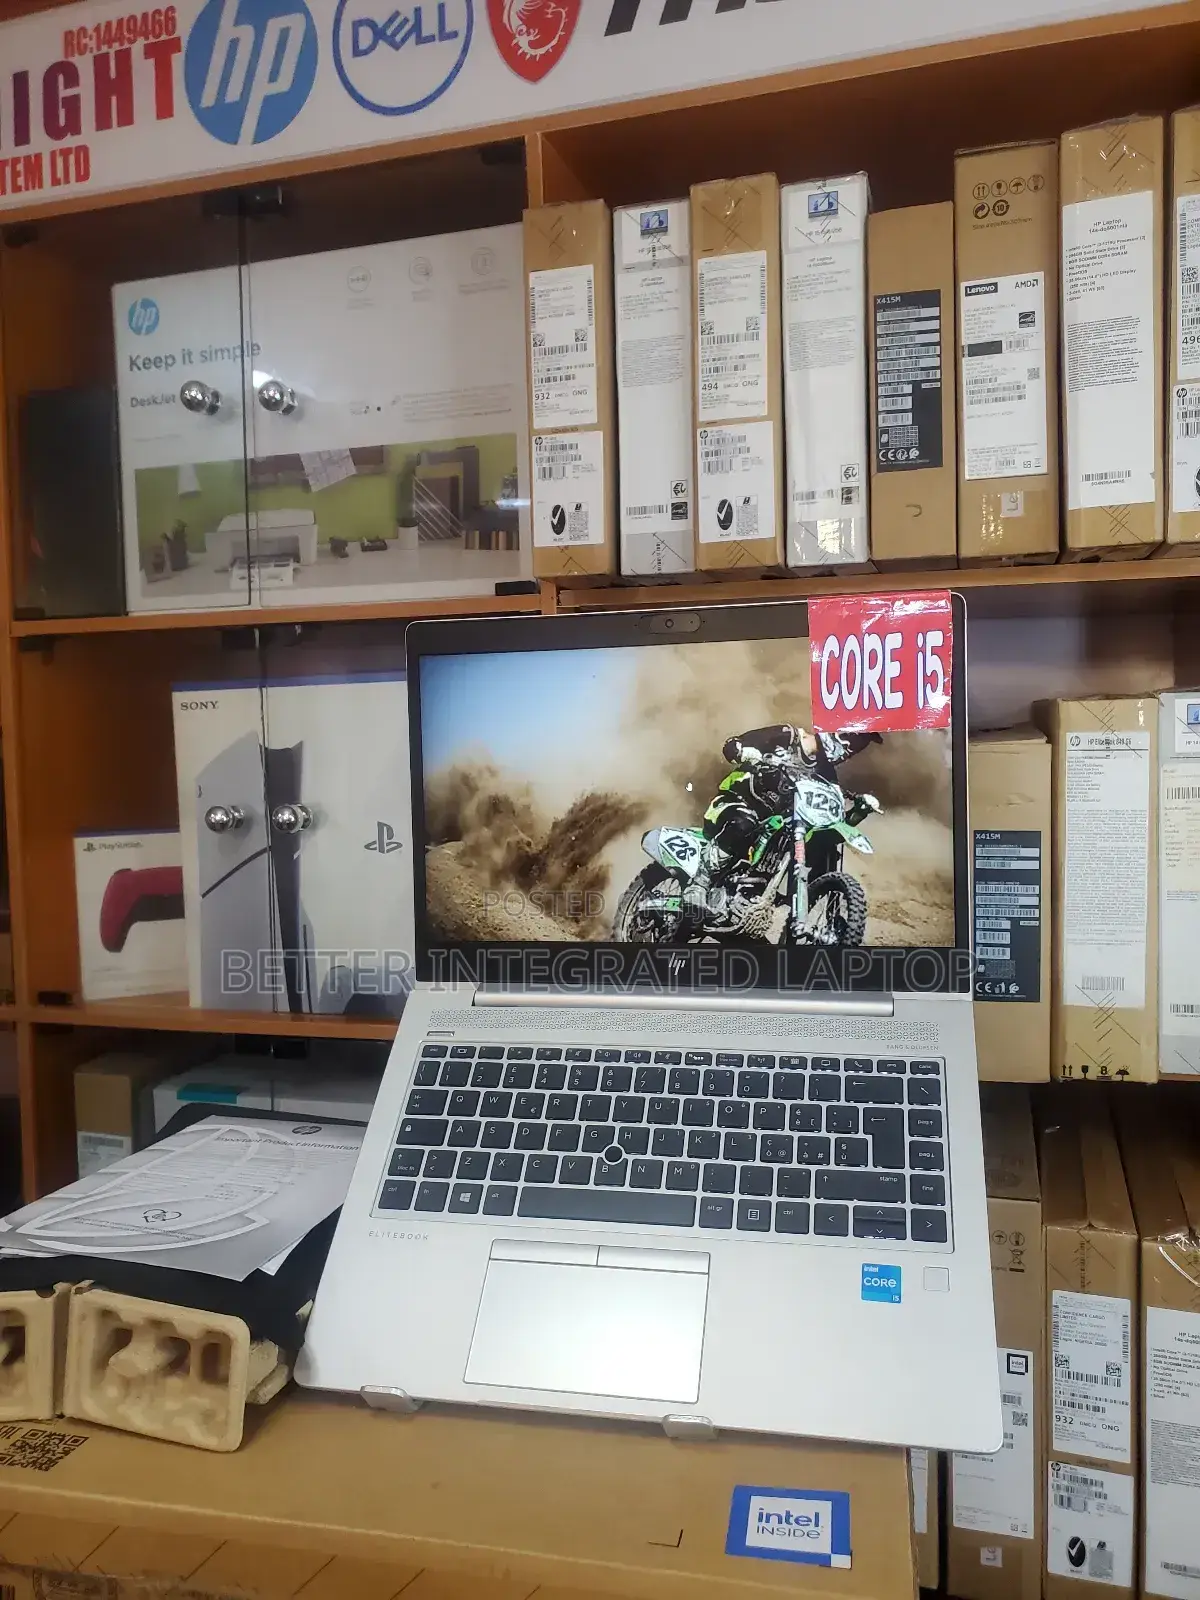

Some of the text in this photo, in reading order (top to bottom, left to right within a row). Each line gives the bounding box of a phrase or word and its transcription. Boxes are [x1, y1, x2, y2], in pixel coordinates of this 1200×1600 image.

[63, 5, 177, 59] RC:1449466
[352, 2, 459, 58] DELL
[0, 36, 183, 149] IGHT
[50, 144, 91, 187] LTD
[967, 285, 995, 294] Lenovo
[1015, 280, 1032, 289] AMD
[876, 295, 901, 304] X415M
[129, 340, 262, 371] Keep it simple
[702, 379, 759, 391] 494 ONG
[534, 392, 550, 400] 932
[820, 630, 944, 710] CORE i5
[180, 700, 219, 711] SONY
[215, 1136, 262, 1144] Important
[263, 1138, 300, 1147] Product
[368, 1230, 430, 1241] ELITEBOOK
[863, 1265, 879, 1273] intel
[1055, 1414, 1120, 1432] 932 ONG
[757, 1506, 820, 1528] intel
